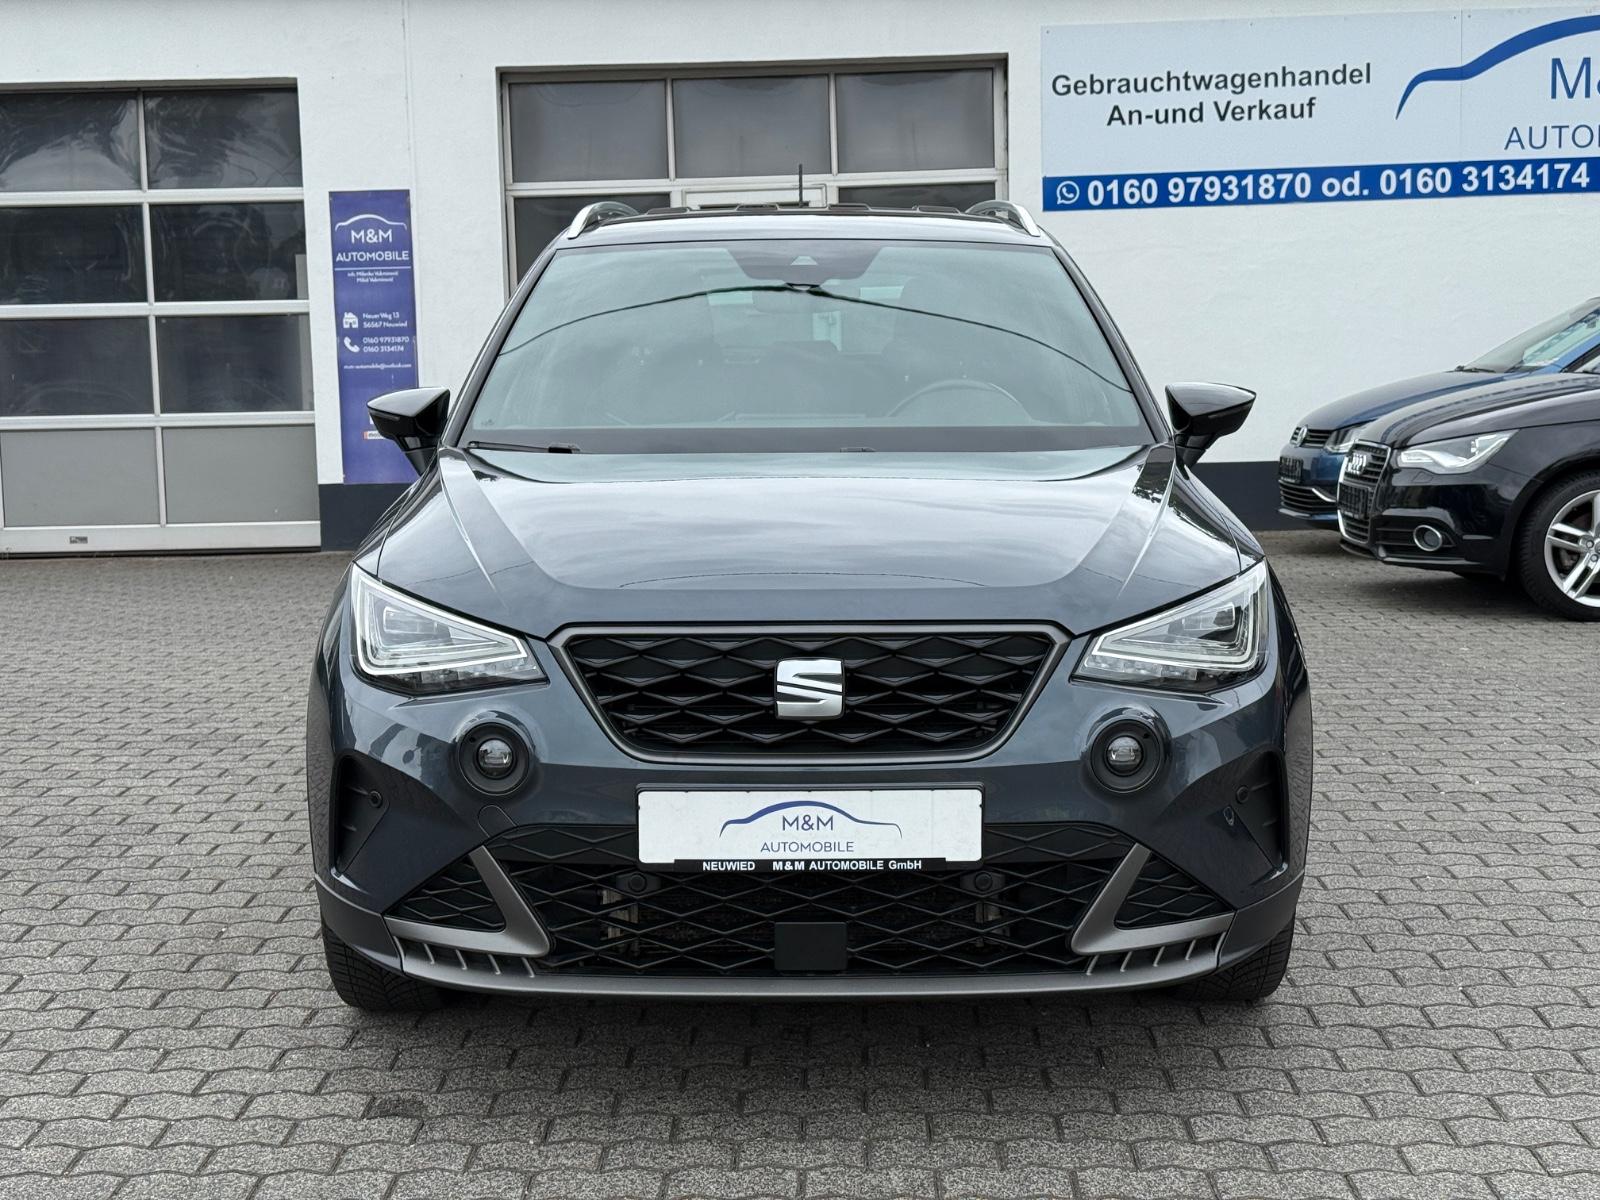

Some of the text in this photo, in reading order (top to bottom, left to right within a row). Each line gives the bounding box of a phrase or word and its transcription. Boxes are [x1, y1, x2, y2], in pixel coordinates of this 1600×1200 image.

[1051, 63, 1372, 97] Gebrauchtwagenhandel
[1106, 97, 1317, 127] An-und Verkauf
[1504, 124, 1600, 150] AUTO
[1087, 162, 1590, 206] 0160 97931870 od. 0160 3134174
[350, 228, 393, 244] M&M
[335, 250, 410, 262] AUTOMOBILE
[380, 345, 404, 353] 3134174
[782, 814, 834, 832] M&M
[760, 841, 855, 853] AUTOMOBILE
[702, 860, 922, 871] NEUWIED M&M AUTOMOBILE GmbH
